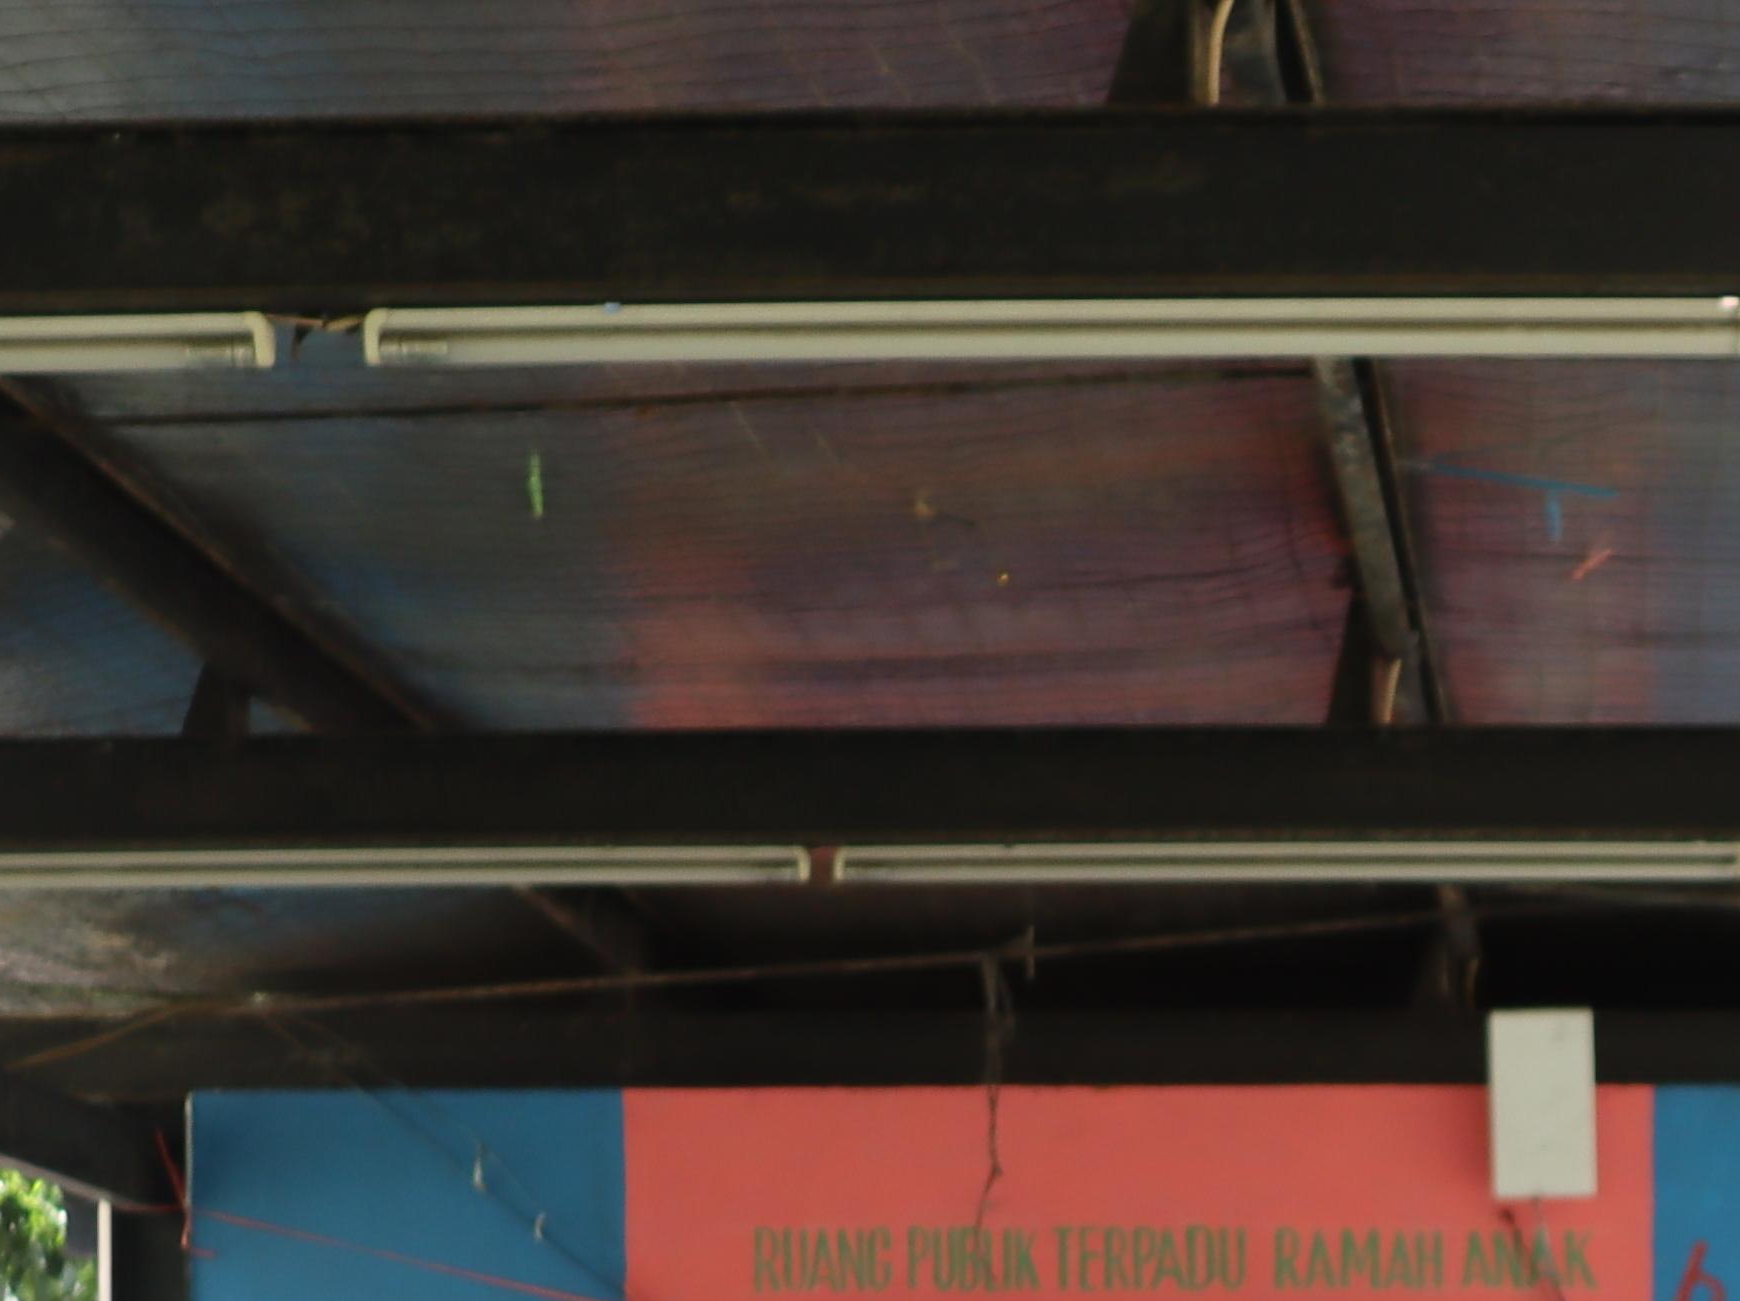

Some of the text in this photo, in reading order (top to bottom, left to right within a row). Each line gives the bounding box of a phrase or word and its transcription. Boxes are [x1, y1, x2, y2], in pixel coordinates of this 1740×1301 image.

[752, 1225, 1599, 1292] RUANG PUBLIK TERPADU RAMAH ANAK
